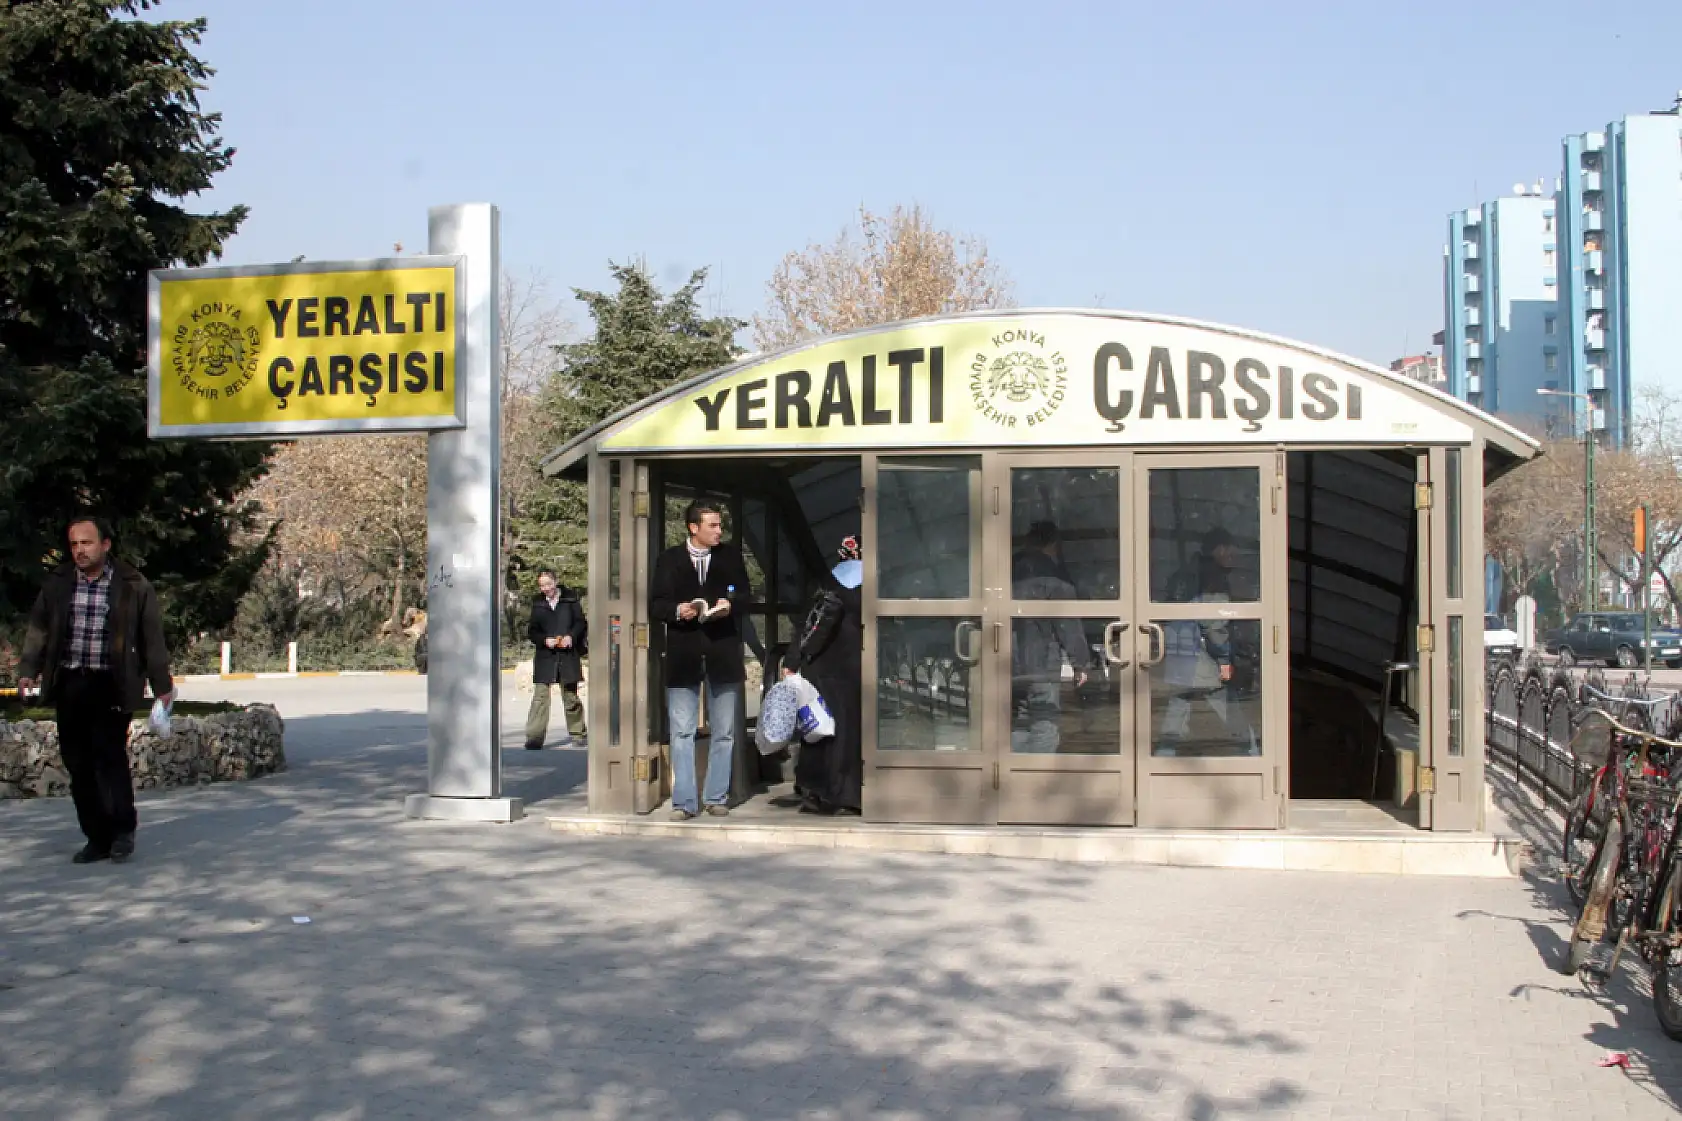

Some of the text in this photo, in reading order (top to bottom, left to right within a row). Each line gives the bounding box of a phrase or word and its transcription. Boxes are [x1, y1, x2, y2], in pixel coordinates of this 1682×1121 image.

[191, 301, 241, 322] KONYA
[266, 292, 445, 338] YERALTI
[992, 328, 1045, 348] KONYA
[267, 351, 444, 410] ÇARŞISI
[693, 341, 1362, 434] YERALTI ÇARŞISI
